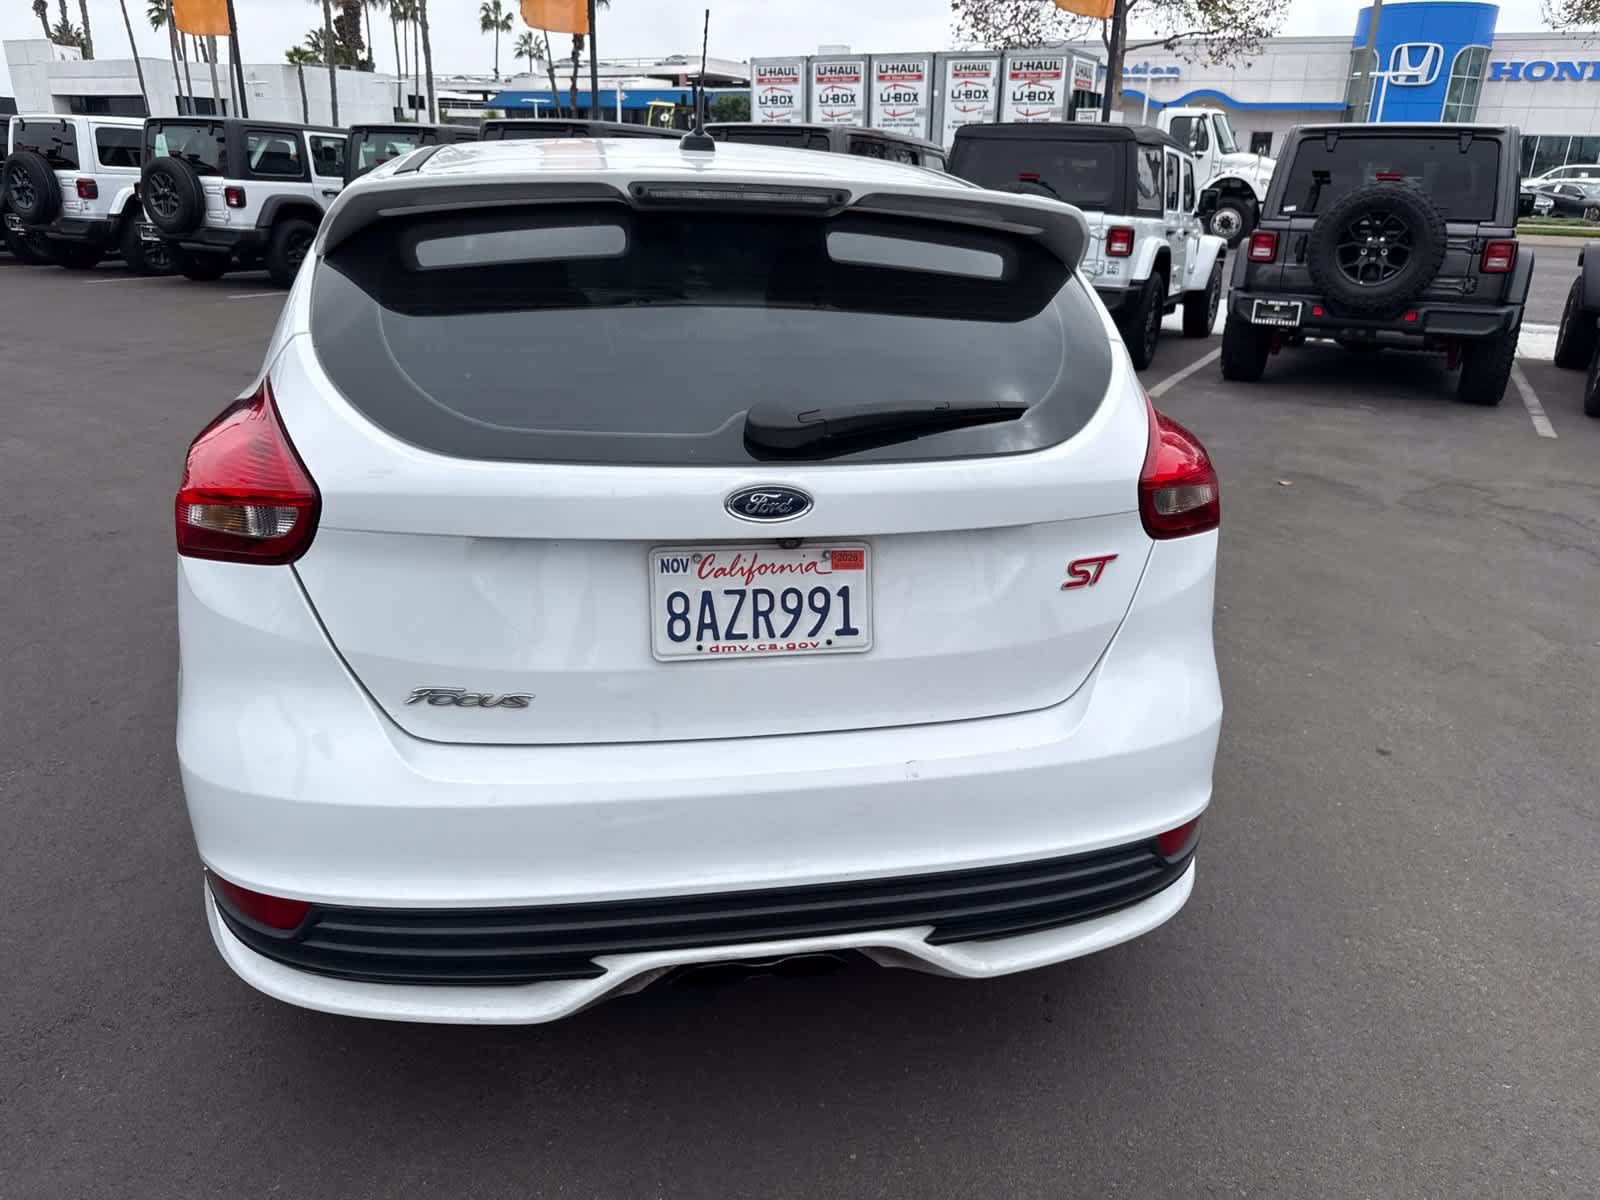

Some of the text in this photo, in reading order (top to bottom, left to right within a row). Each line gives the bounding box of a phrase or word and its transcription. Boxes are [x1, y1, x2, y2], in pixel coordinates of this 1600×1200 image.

[879, 63, 923, 73] U-HAUL
[1012, 61, 1060, 71] U-HAUL
[819, 93, 857, 104] U-BOX
[880, 92, 919, 103] U-BOX
[951, 89, 989, 99] U-BOX
[1012, 91, 1055, 102] U-BOX
[758, 95, 794, 105] U-BOX
[745, 492, 793, 514] Ford
[660, 557, 689, 574] NOV
[697, 552, 833, 586] California
[1060, 554, 1119, 591] ST
[666, 584, 860, 643] 8AZR991
[709, 641, 820, 653] dmv.ca.gov
